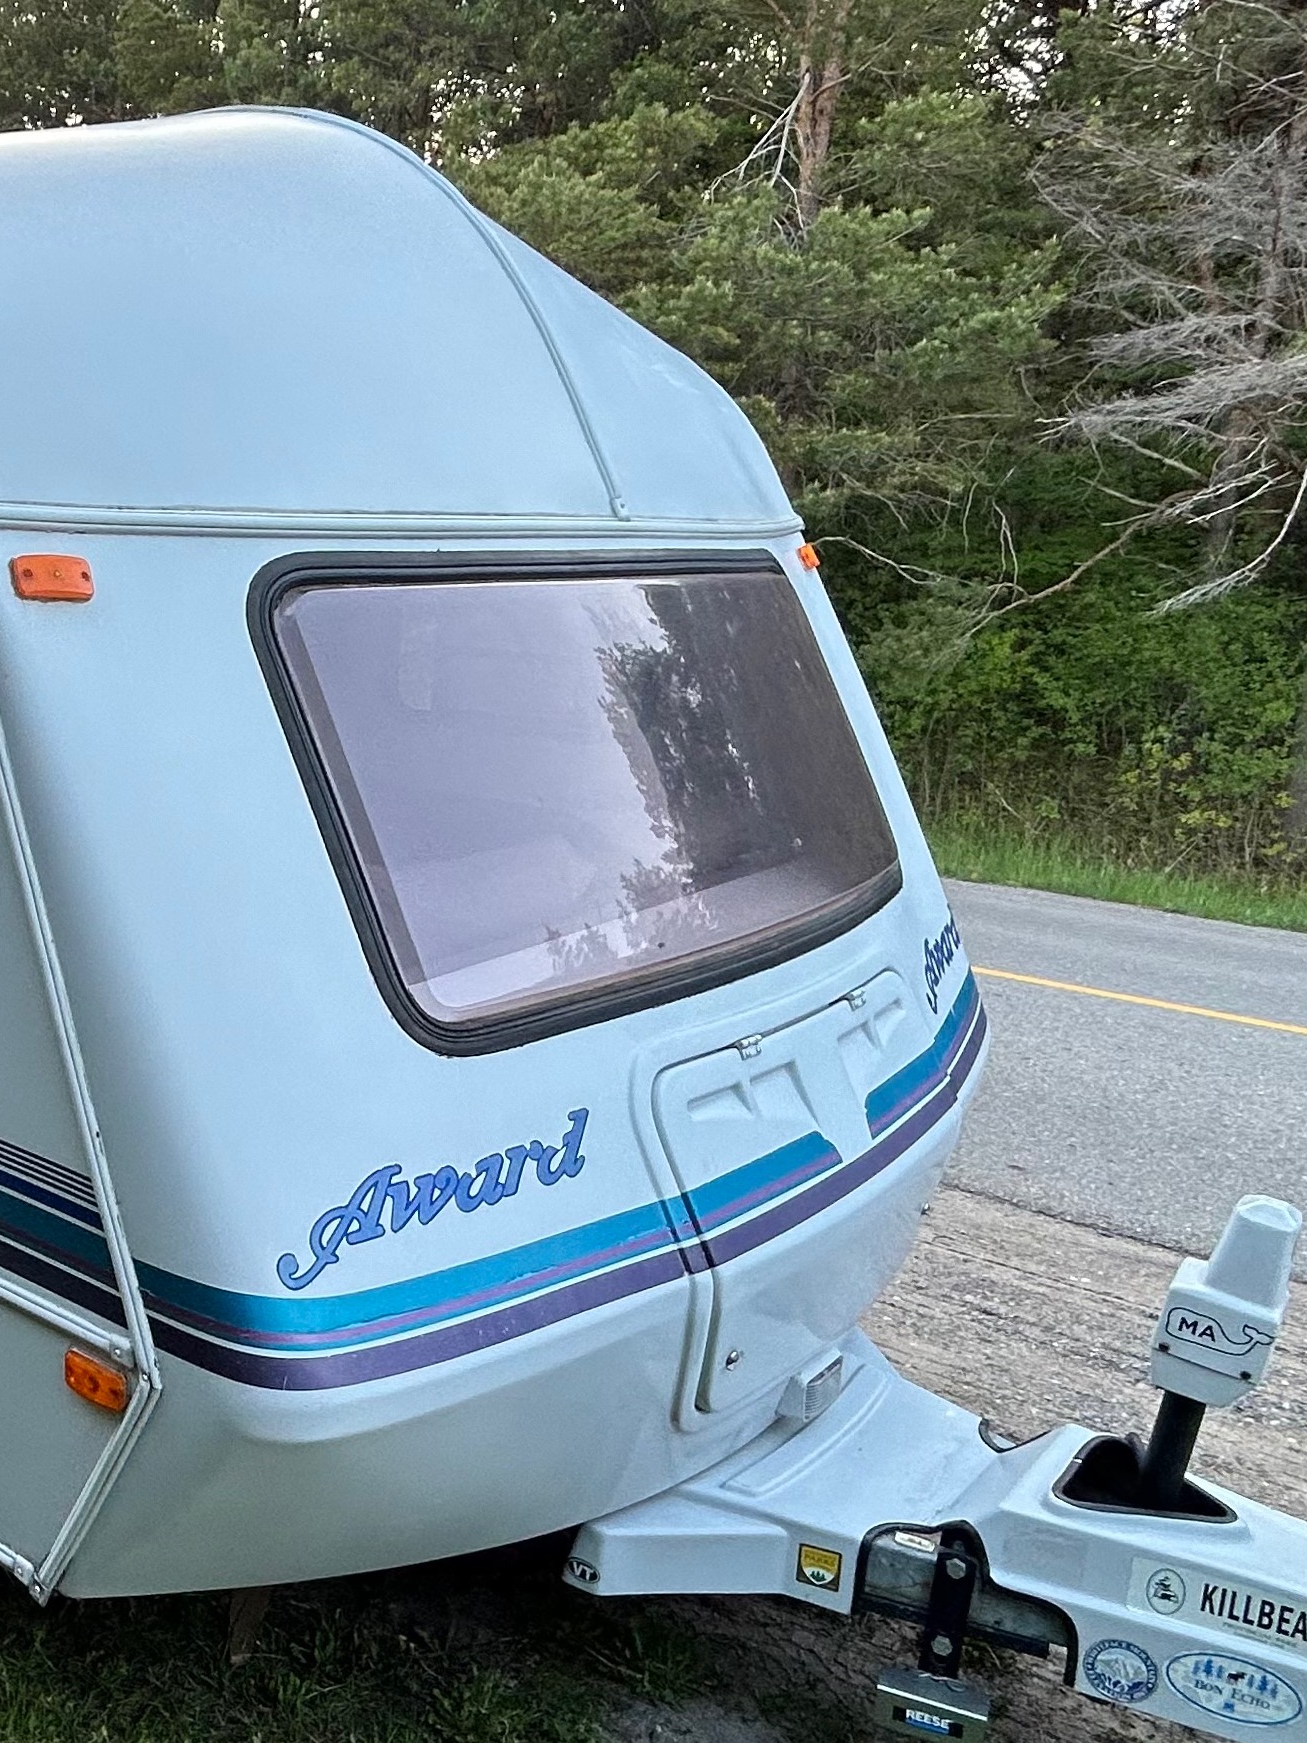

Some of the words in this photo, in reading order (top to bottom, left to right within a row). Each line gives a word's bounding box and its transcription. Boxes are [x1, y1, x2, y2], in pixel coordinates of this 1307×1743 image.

[275, 1107, 590, 1291] Award
[1177, 1316, 1216, 1343] MA
[572, 1561, 595, 1581] VT
[1230, 1683, 1271, 1711] ECHO
[905, 1708, 951, 1730] REESE
